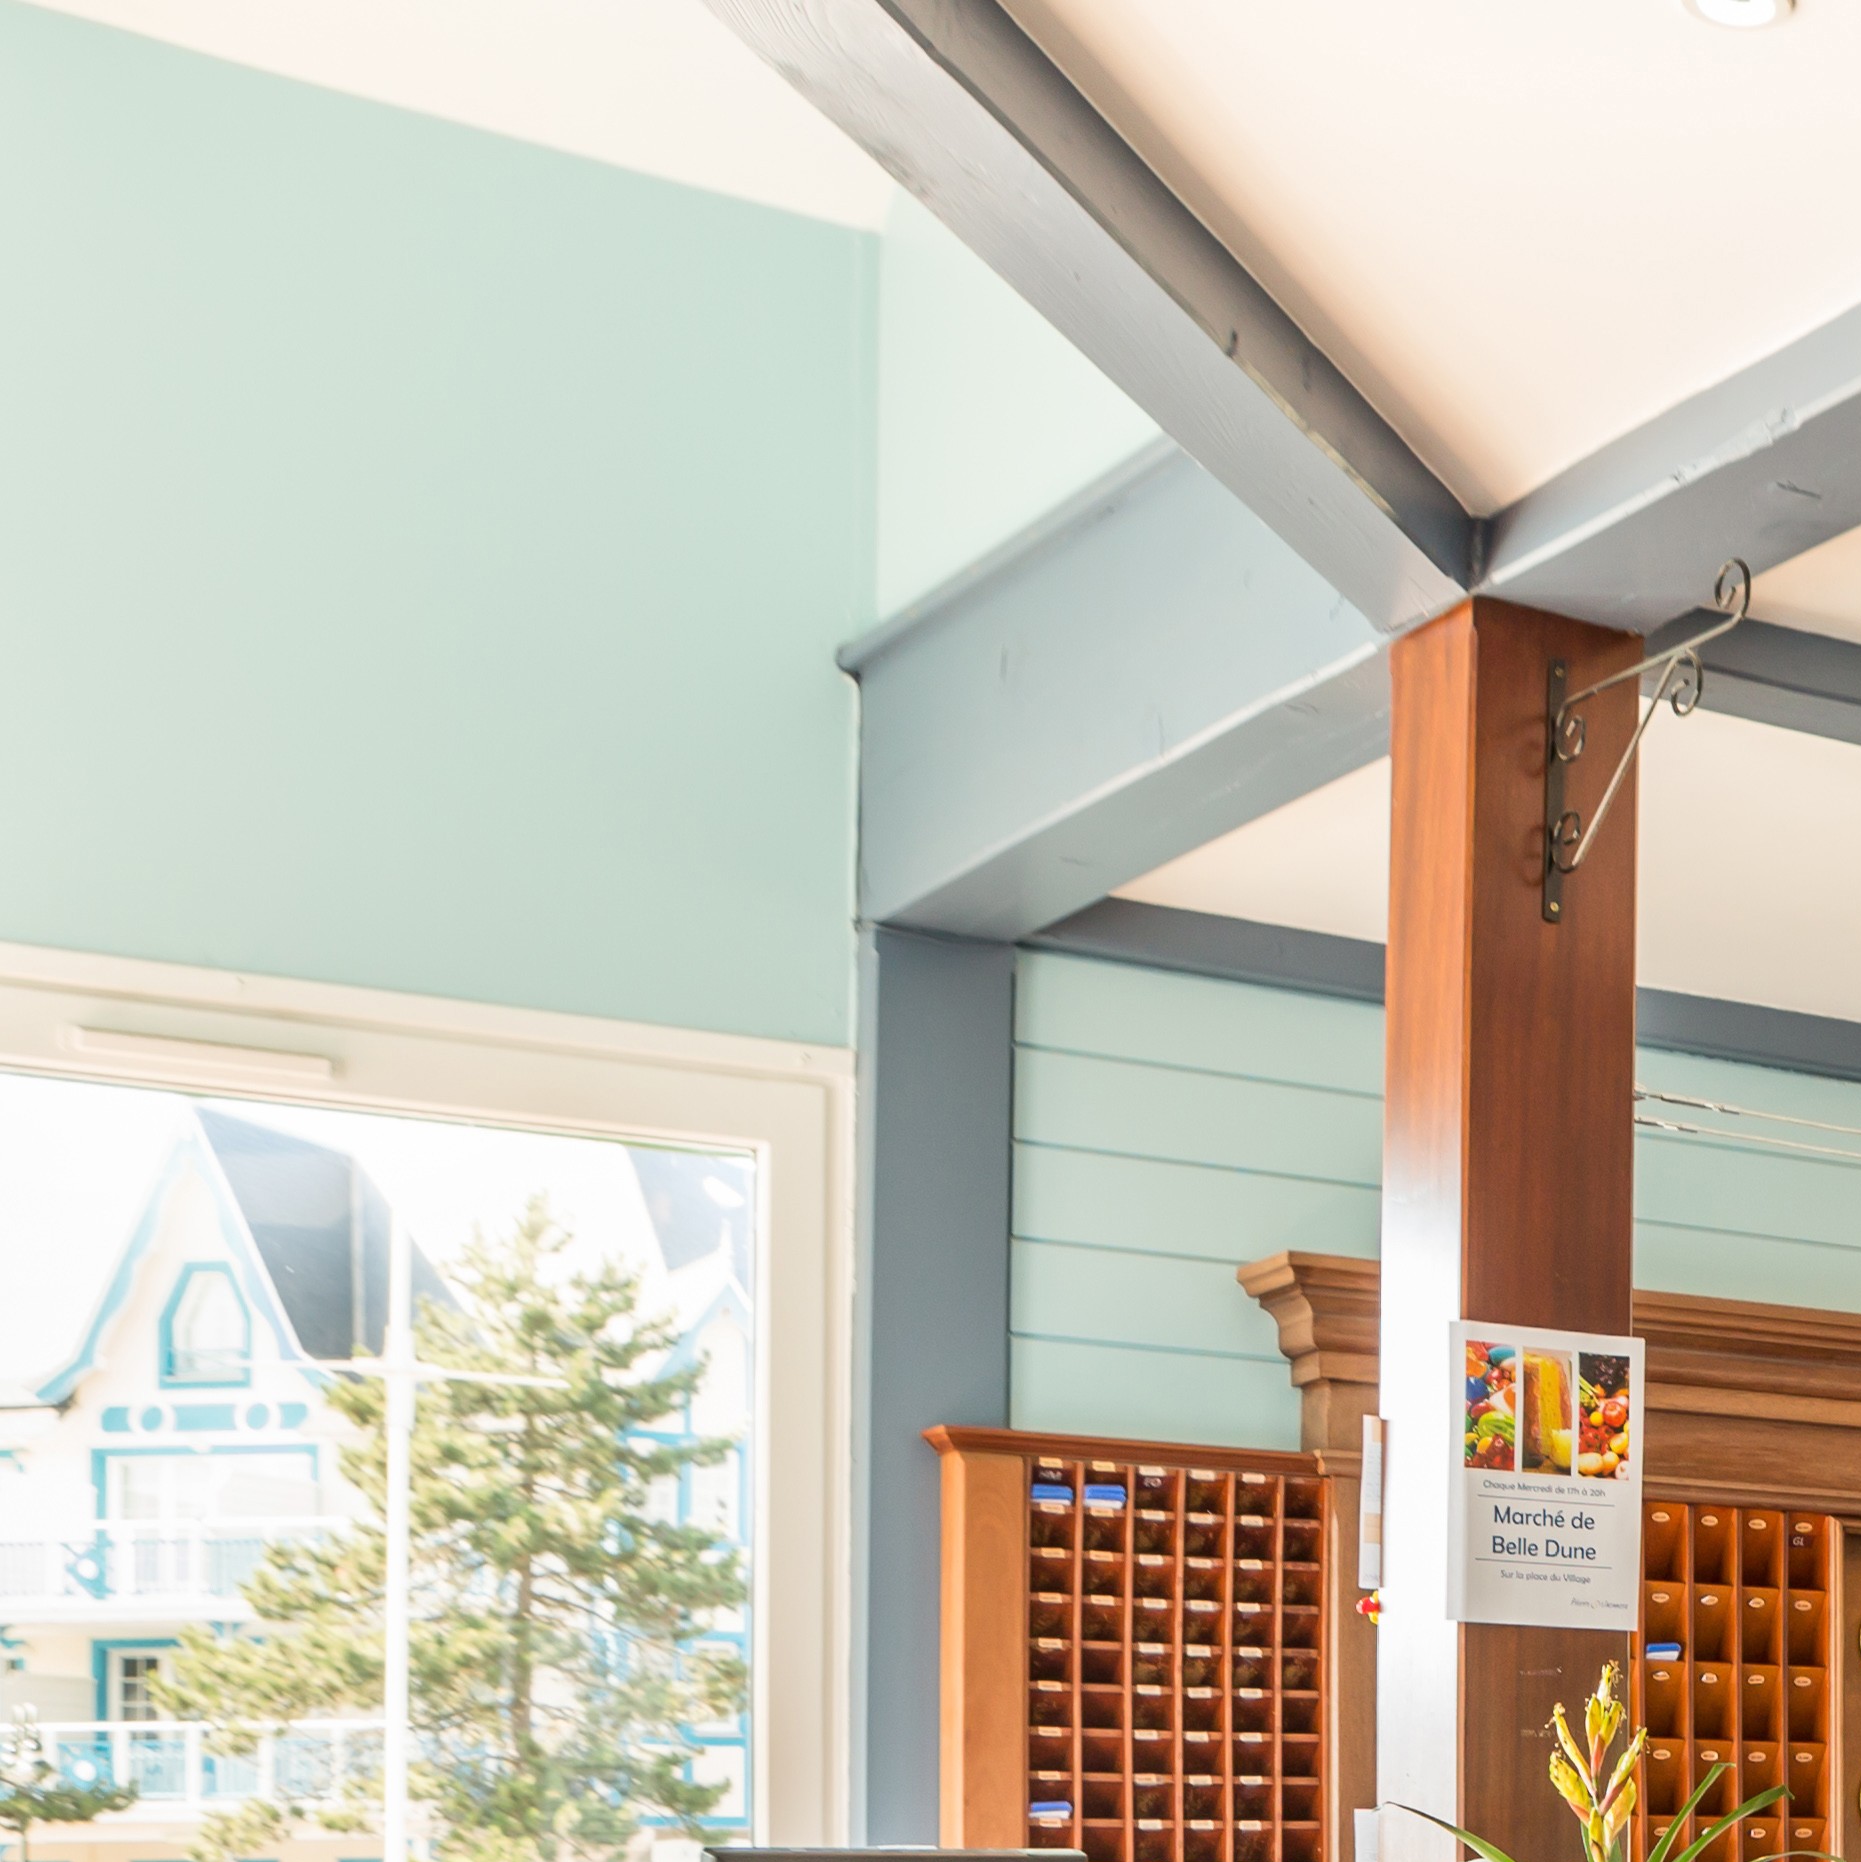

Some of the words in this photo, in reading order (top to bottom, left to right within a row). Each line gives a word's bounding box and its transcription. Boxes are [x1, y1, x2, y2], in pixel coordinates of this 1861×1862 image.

[1493, 1504, 1565, 1528] Marché
[1571, 1511, 1596, 1530] de
[1492, 1535, 1539, 1556] Belle
[1545, 1539, 1597, 1560] Dune
[1500, 1569, 1514, 1579] Sur
[1526, 1571, 1548, 1582] place
[1550, 1572, 1561, 1582] du
[1563, 1573, 1591, 1584] Village
